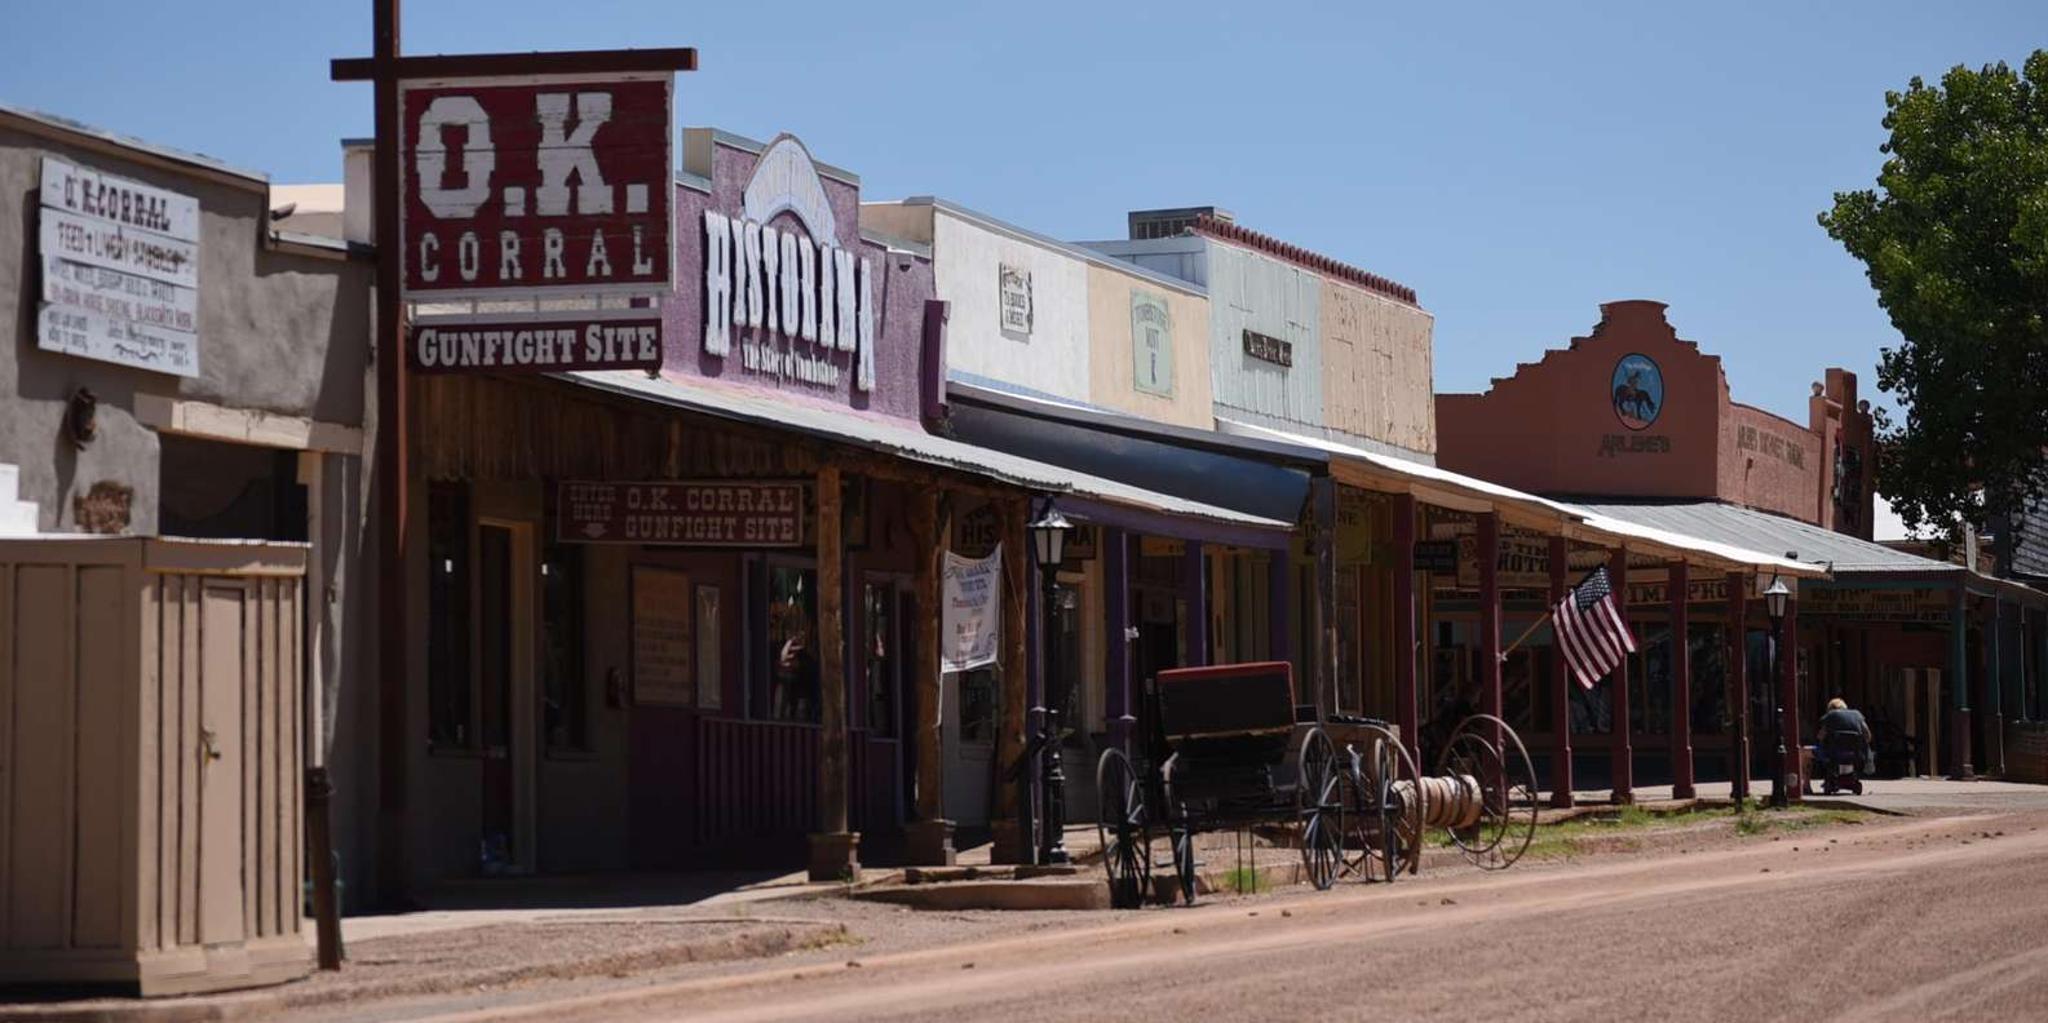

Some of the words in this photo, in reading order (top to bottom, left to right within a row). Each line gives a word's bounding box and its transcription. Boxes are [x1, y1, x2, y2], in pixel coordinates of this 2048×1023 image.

[415, 91, 649, 219] O.K.
[97, 183, 171, 231] CORRAL
[419, 224, 654, 282] CORRAL
[705, 209, 876, 391] HISTORAMA
[417, 328, 577, 367] GUNFIGHT
[585, 323, 658, 362] SITE
[626, 487, 678, 511] O.K.
[687, 488, 793, 511] CORRAL
[624, 514, 737, 540] GUNFIGHT
[744, 517, 793, 541] SITE
